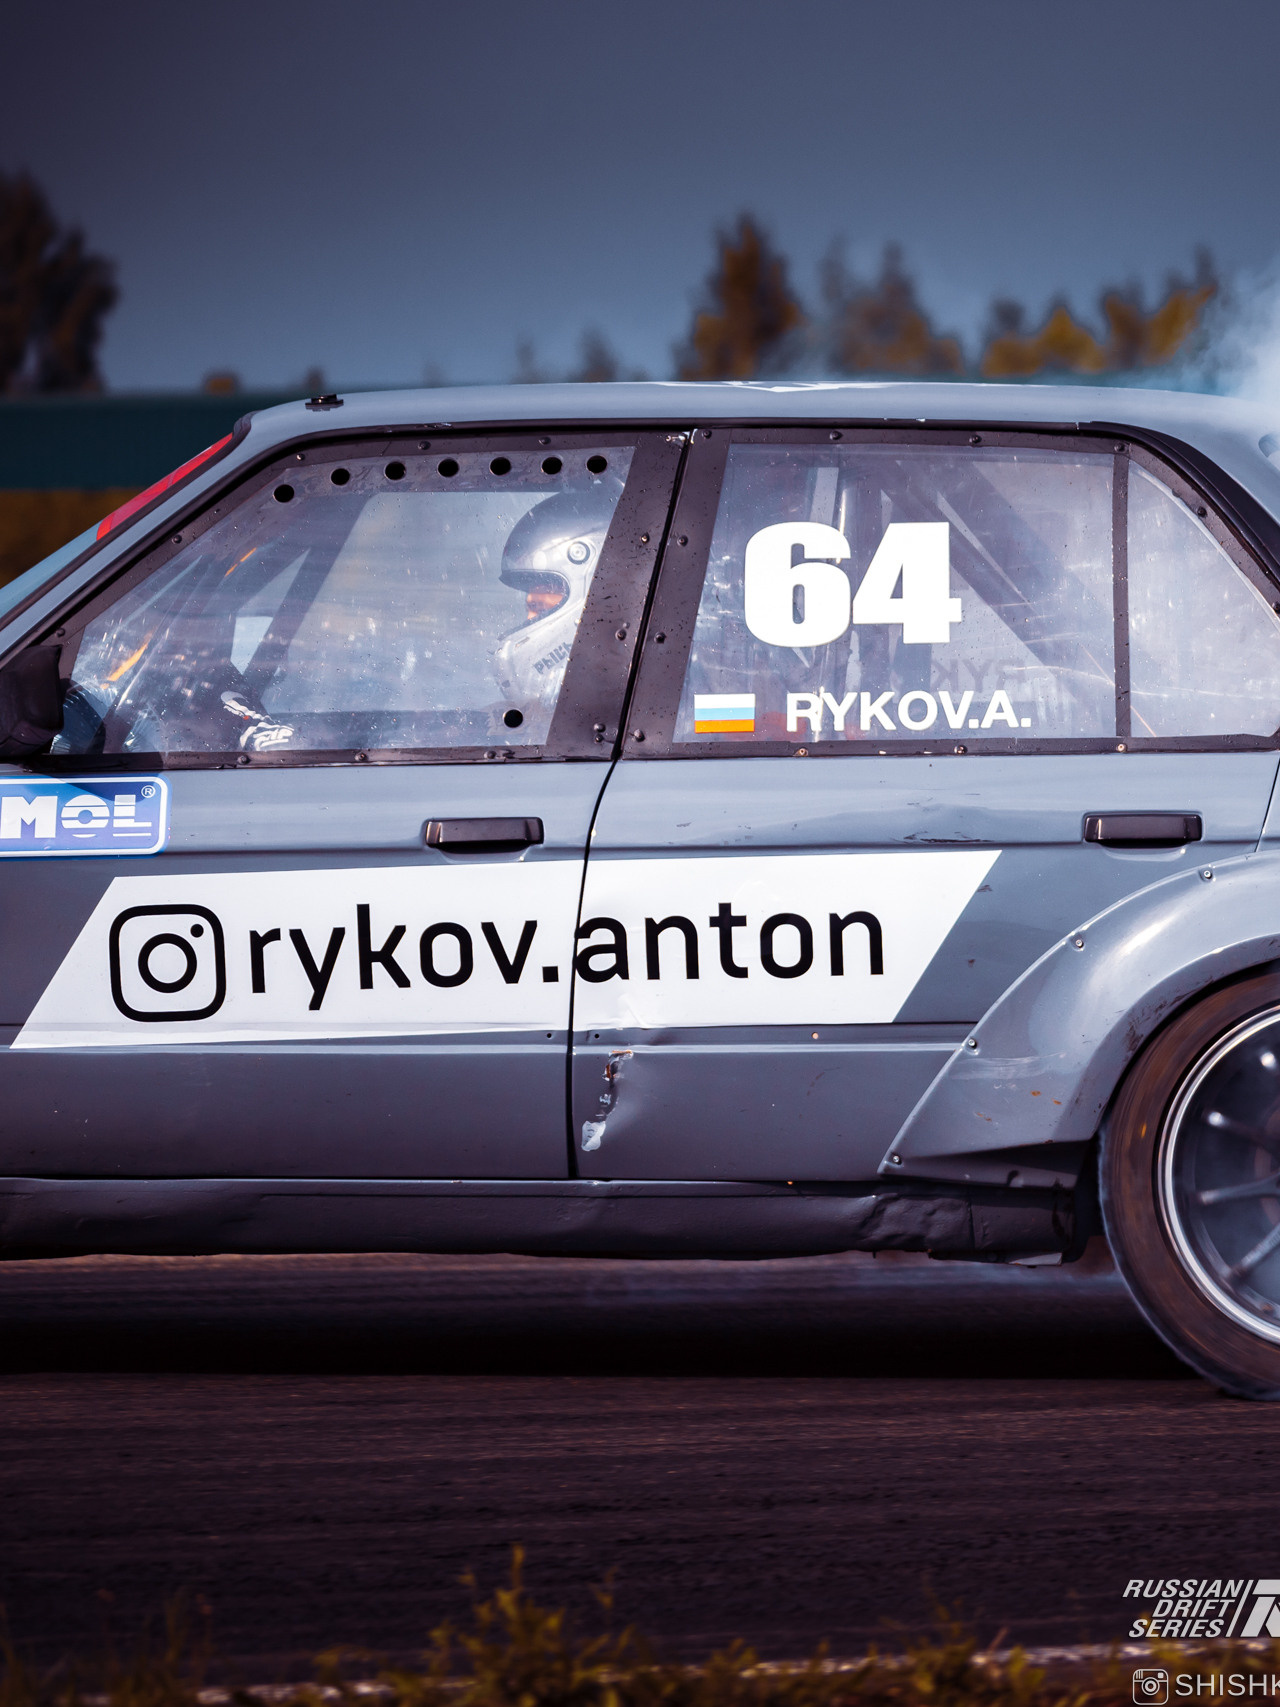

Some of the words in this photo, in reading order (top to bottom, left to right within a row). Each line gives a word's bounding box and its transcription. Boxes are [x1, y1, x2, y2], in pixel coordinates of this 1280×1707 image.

[744, 521, 962, 648] 64
[786, 689, 1032, 732] RYKOV.A.
[249, 902, 885, 1011] rykov.anton
